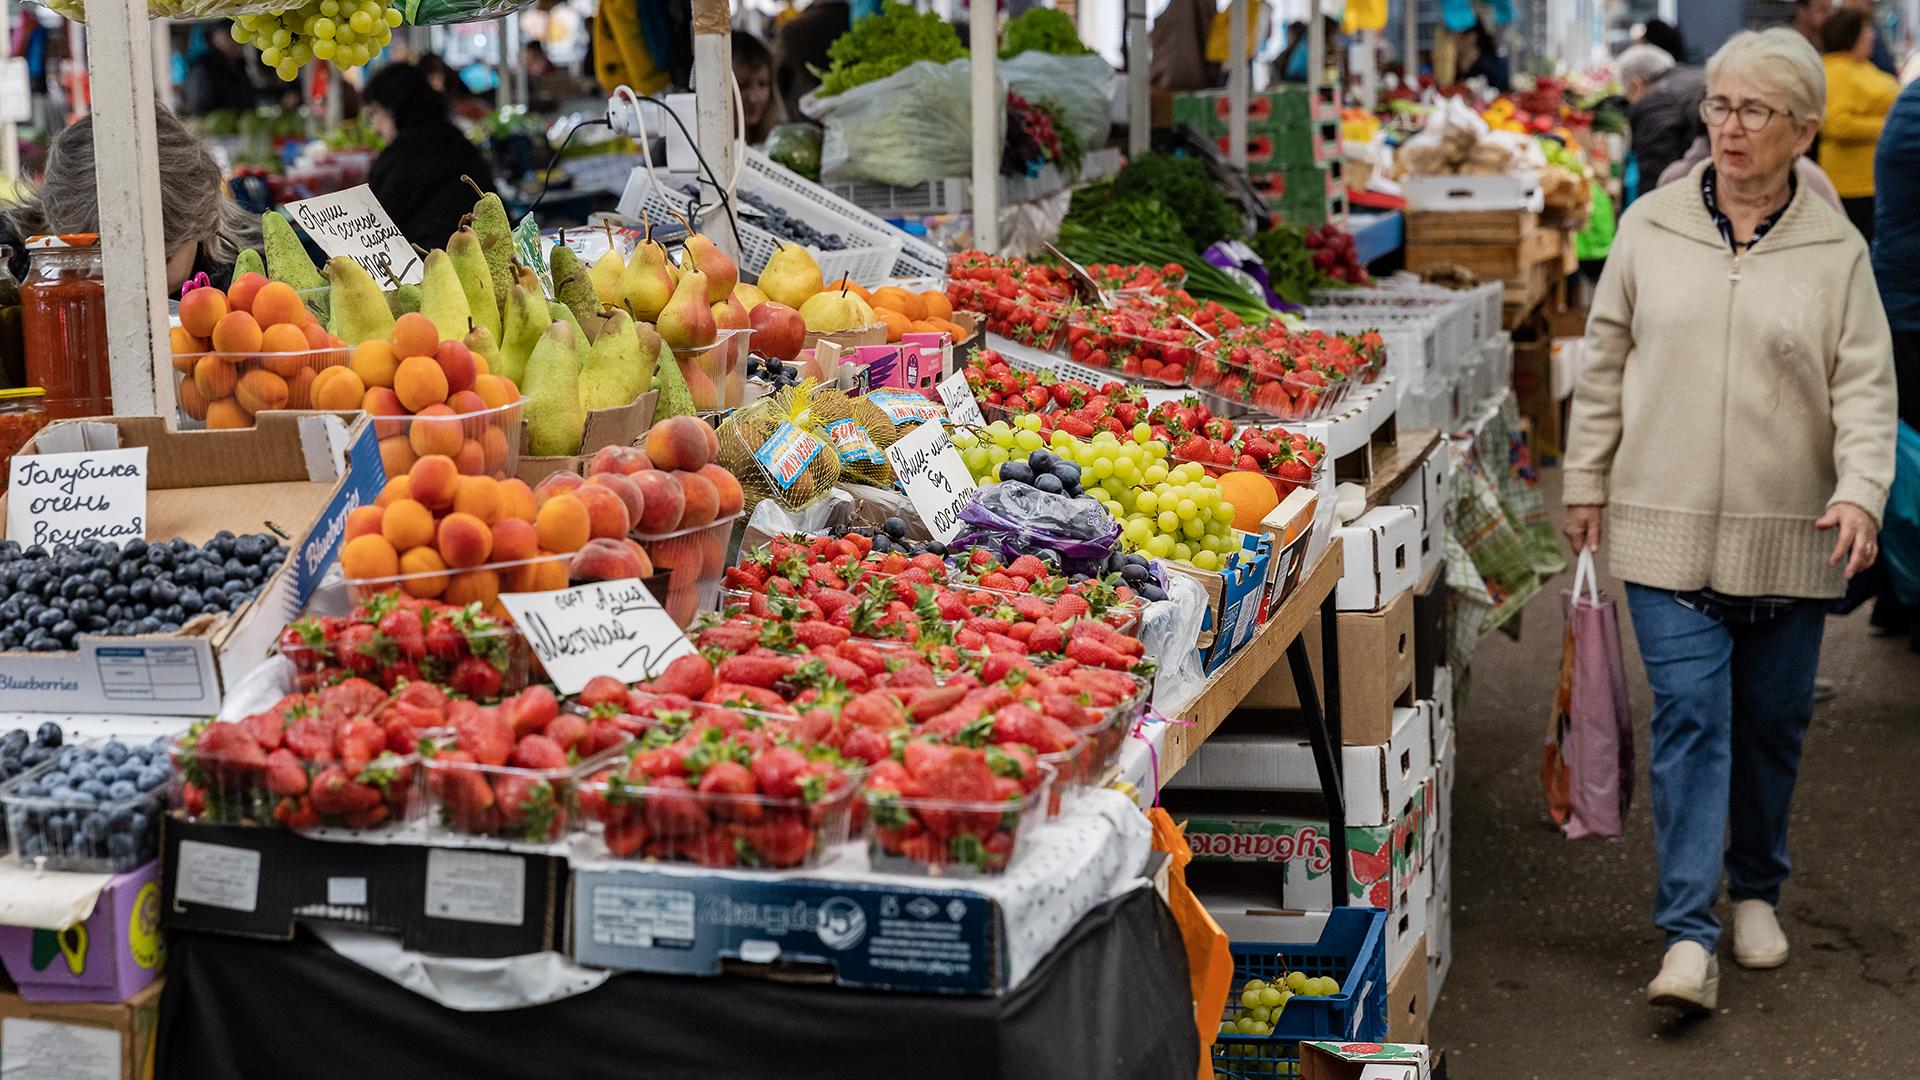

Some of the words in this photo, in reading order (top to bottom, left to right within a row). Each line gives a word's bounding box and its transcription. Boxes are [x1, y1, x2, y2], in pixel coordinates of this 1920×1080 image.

[298, 203, 348, 235] Груши
[337, 212, 381, 240] сочные
[779, 452, 803, 482] KIWI
[30, 494, 111, 515] очень
[524, 611, 638, 662] Местная
[0, 674, 80, 692] Blueberries
